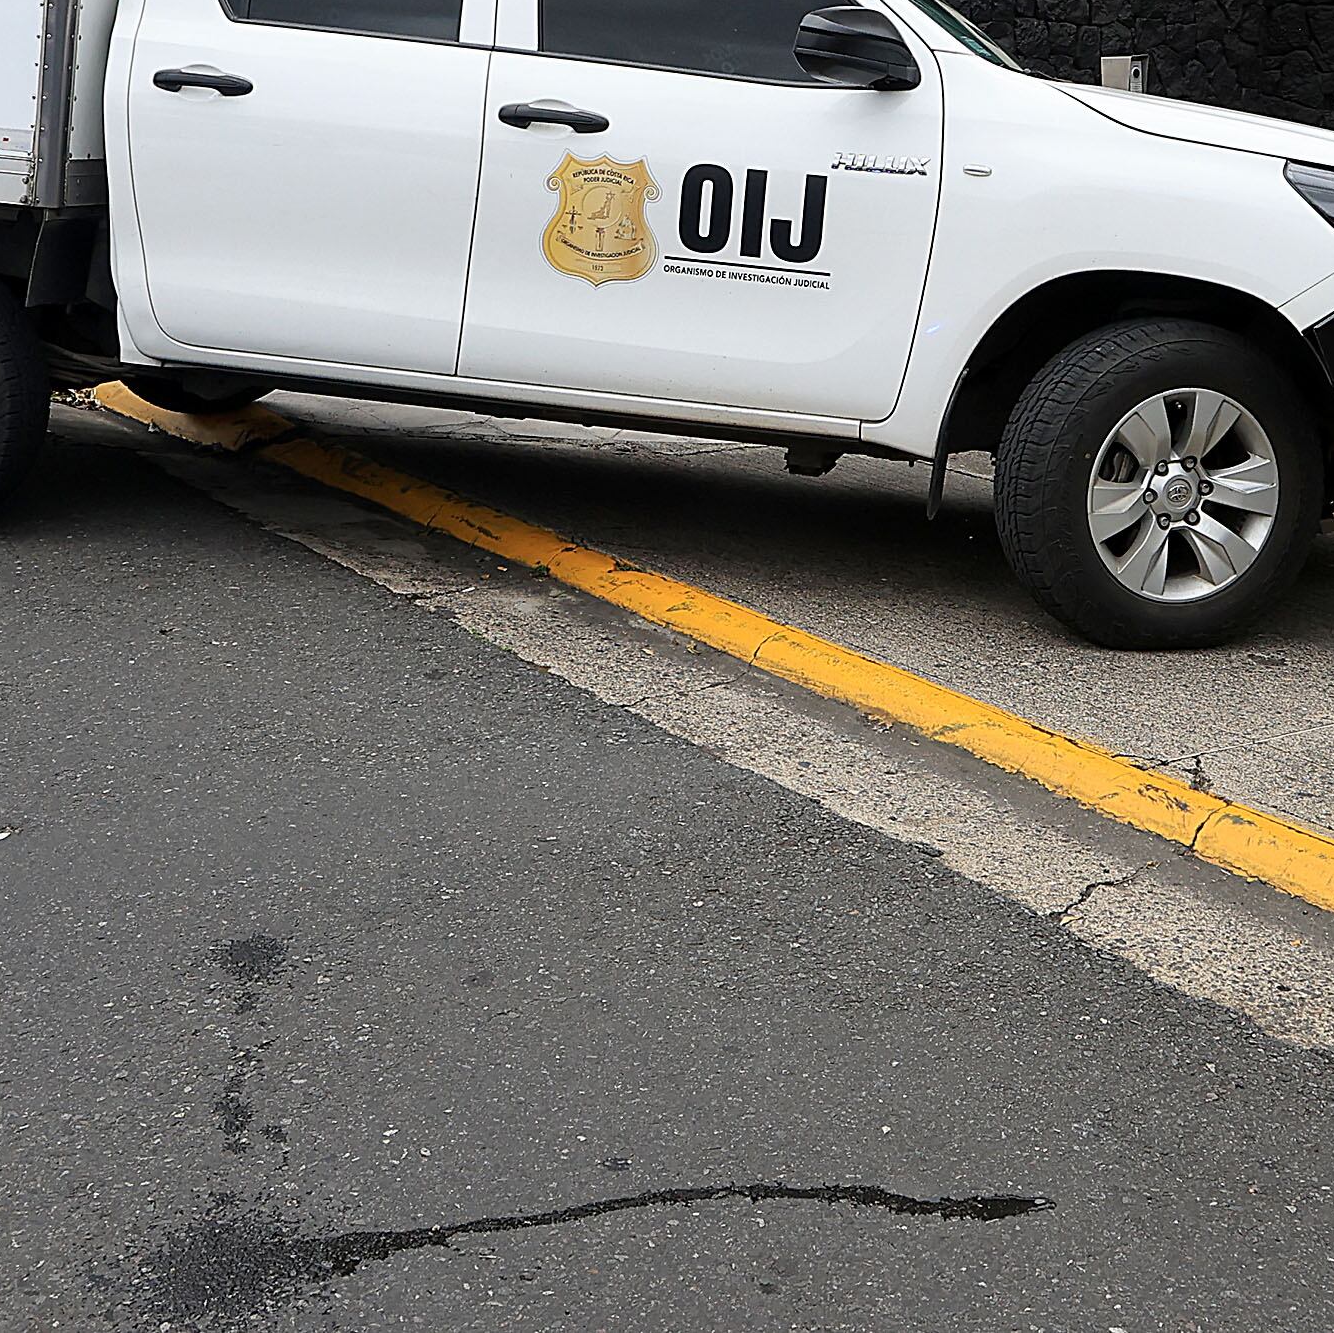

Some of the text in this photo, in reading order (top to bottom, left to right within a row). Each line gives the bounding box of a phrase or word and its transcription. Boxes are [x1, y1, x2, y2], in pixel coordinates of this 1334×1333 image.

[831, 152, 931, 176] HILUX
[678, 163, 828, 263] OIJ
[663, 264, 830, 290] ORGANISMO DE INVESTIGACIÓN JUDICIAL
